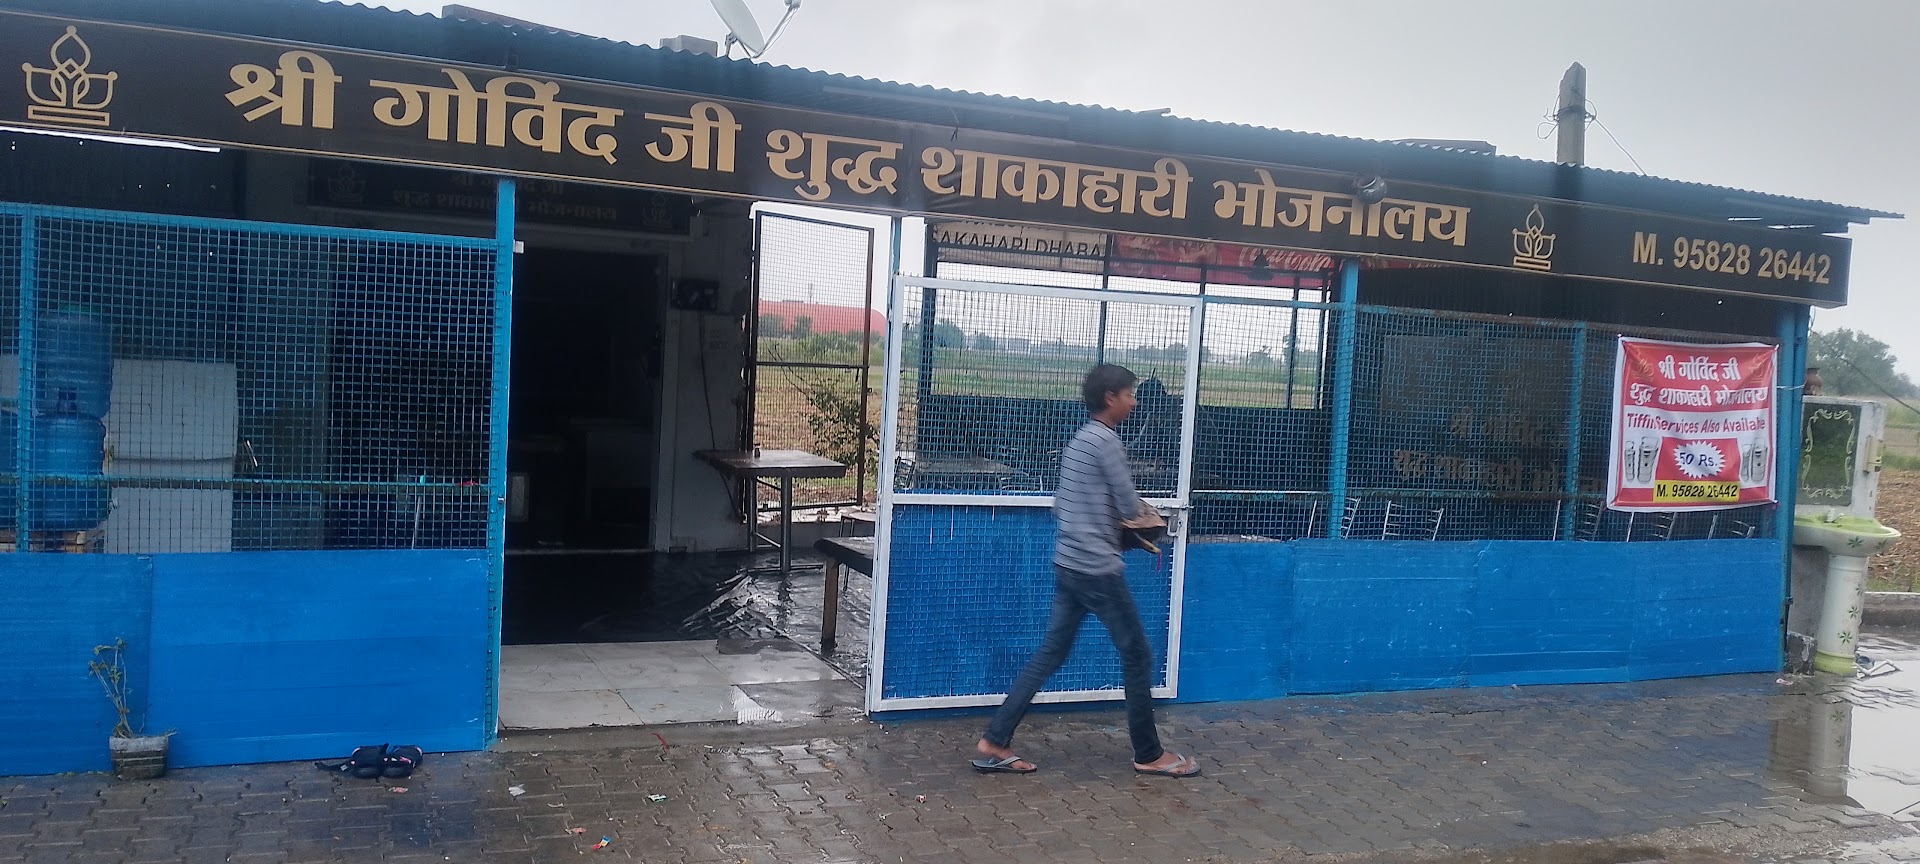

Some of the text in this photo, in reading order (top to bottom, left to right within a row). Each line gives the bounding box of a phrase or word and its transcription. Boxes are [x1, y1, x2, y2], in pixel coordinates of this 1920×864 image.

[224, 51, 1471, 248] श्री गोविंद जी शुद्ध शाकाहारी भोजनालय
[1035, 238, 1101, 258] DHABA
[1633, 231, 1832, 285] M. 95828 26442
[1658, 355, 1676, 380] श्री
[1720, 357, 1741, 381] जी
[1658, 385, 1713, 407] शाकाहारी
[1655, 416, 1699, 433] Services
[1700, 418, 1720, 433] Also
[1679, 452, 1718, 467] 50 Rs.
[1656, 484, 1738, 498] M. 95828 26442
